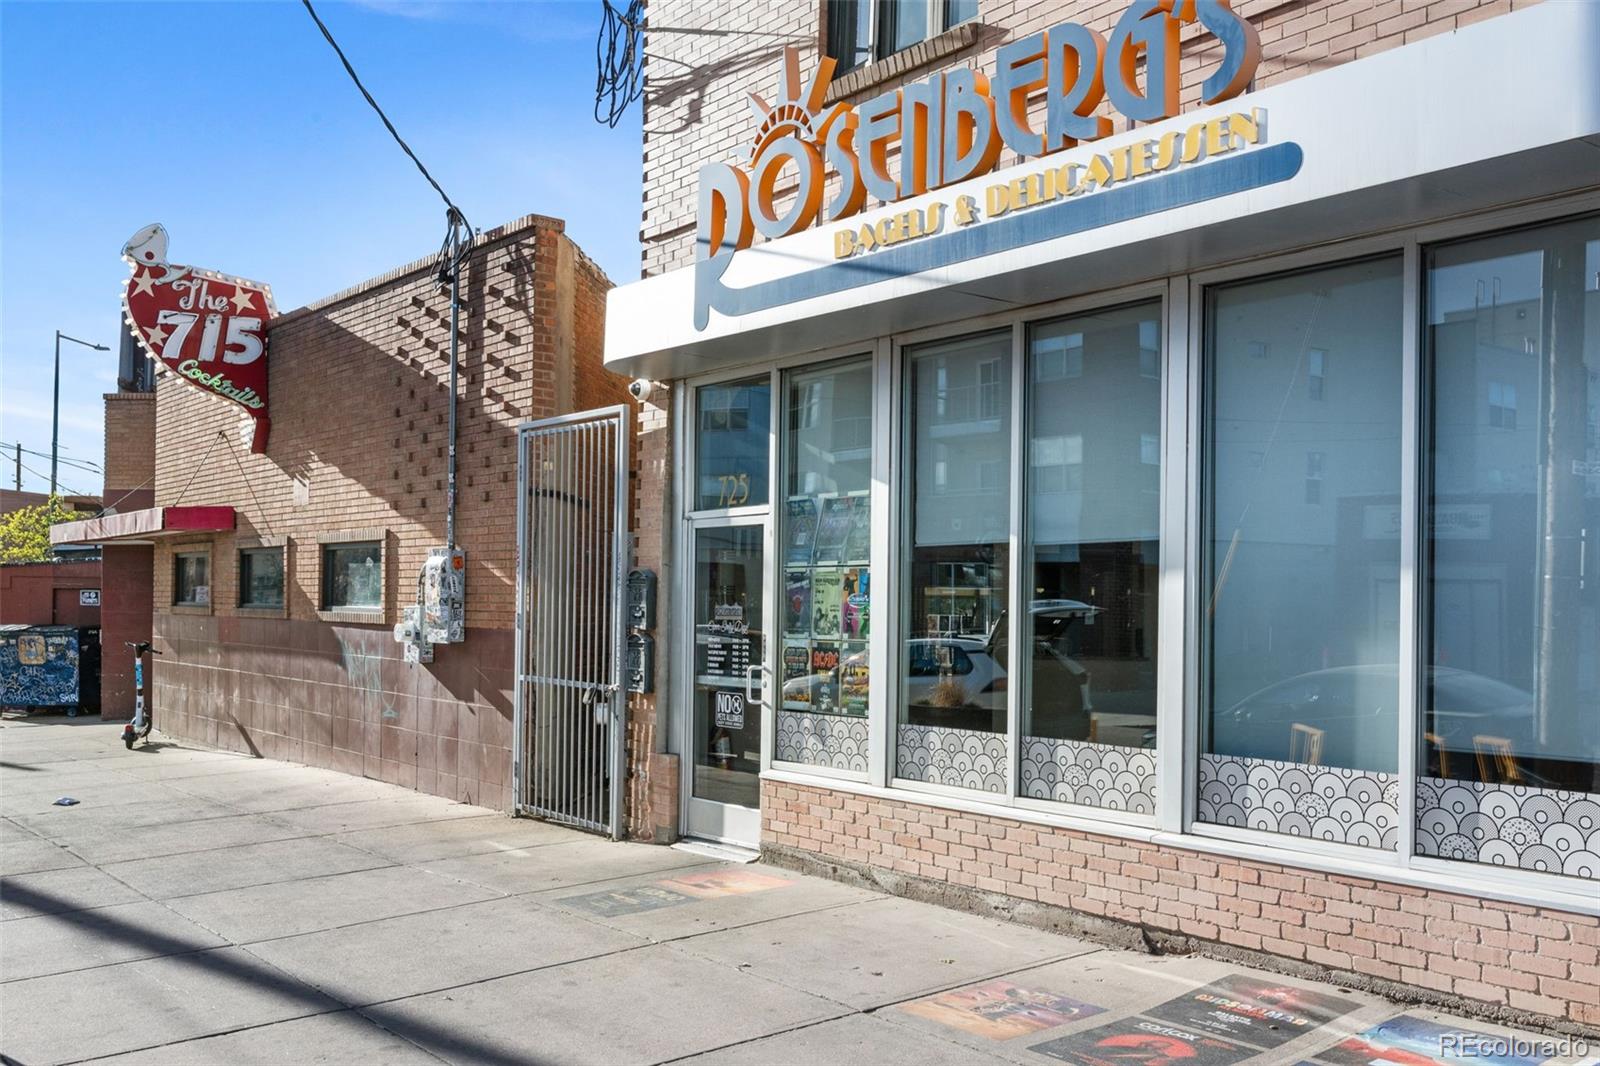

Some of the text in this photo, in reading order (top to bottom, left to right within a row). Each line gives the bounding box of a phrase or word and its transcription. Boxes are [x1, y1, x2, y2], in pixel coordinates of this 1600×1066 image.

[833, 106, 1263, 259] BAGELS & DELICATESSEN
[171, 278, 229, 311] The
[156, 310, 264, 366] 715
[177, 359, 264, 409] Cocktails
[718, 473, 749, 506] 725
[717, 694, 731, 713] NO
